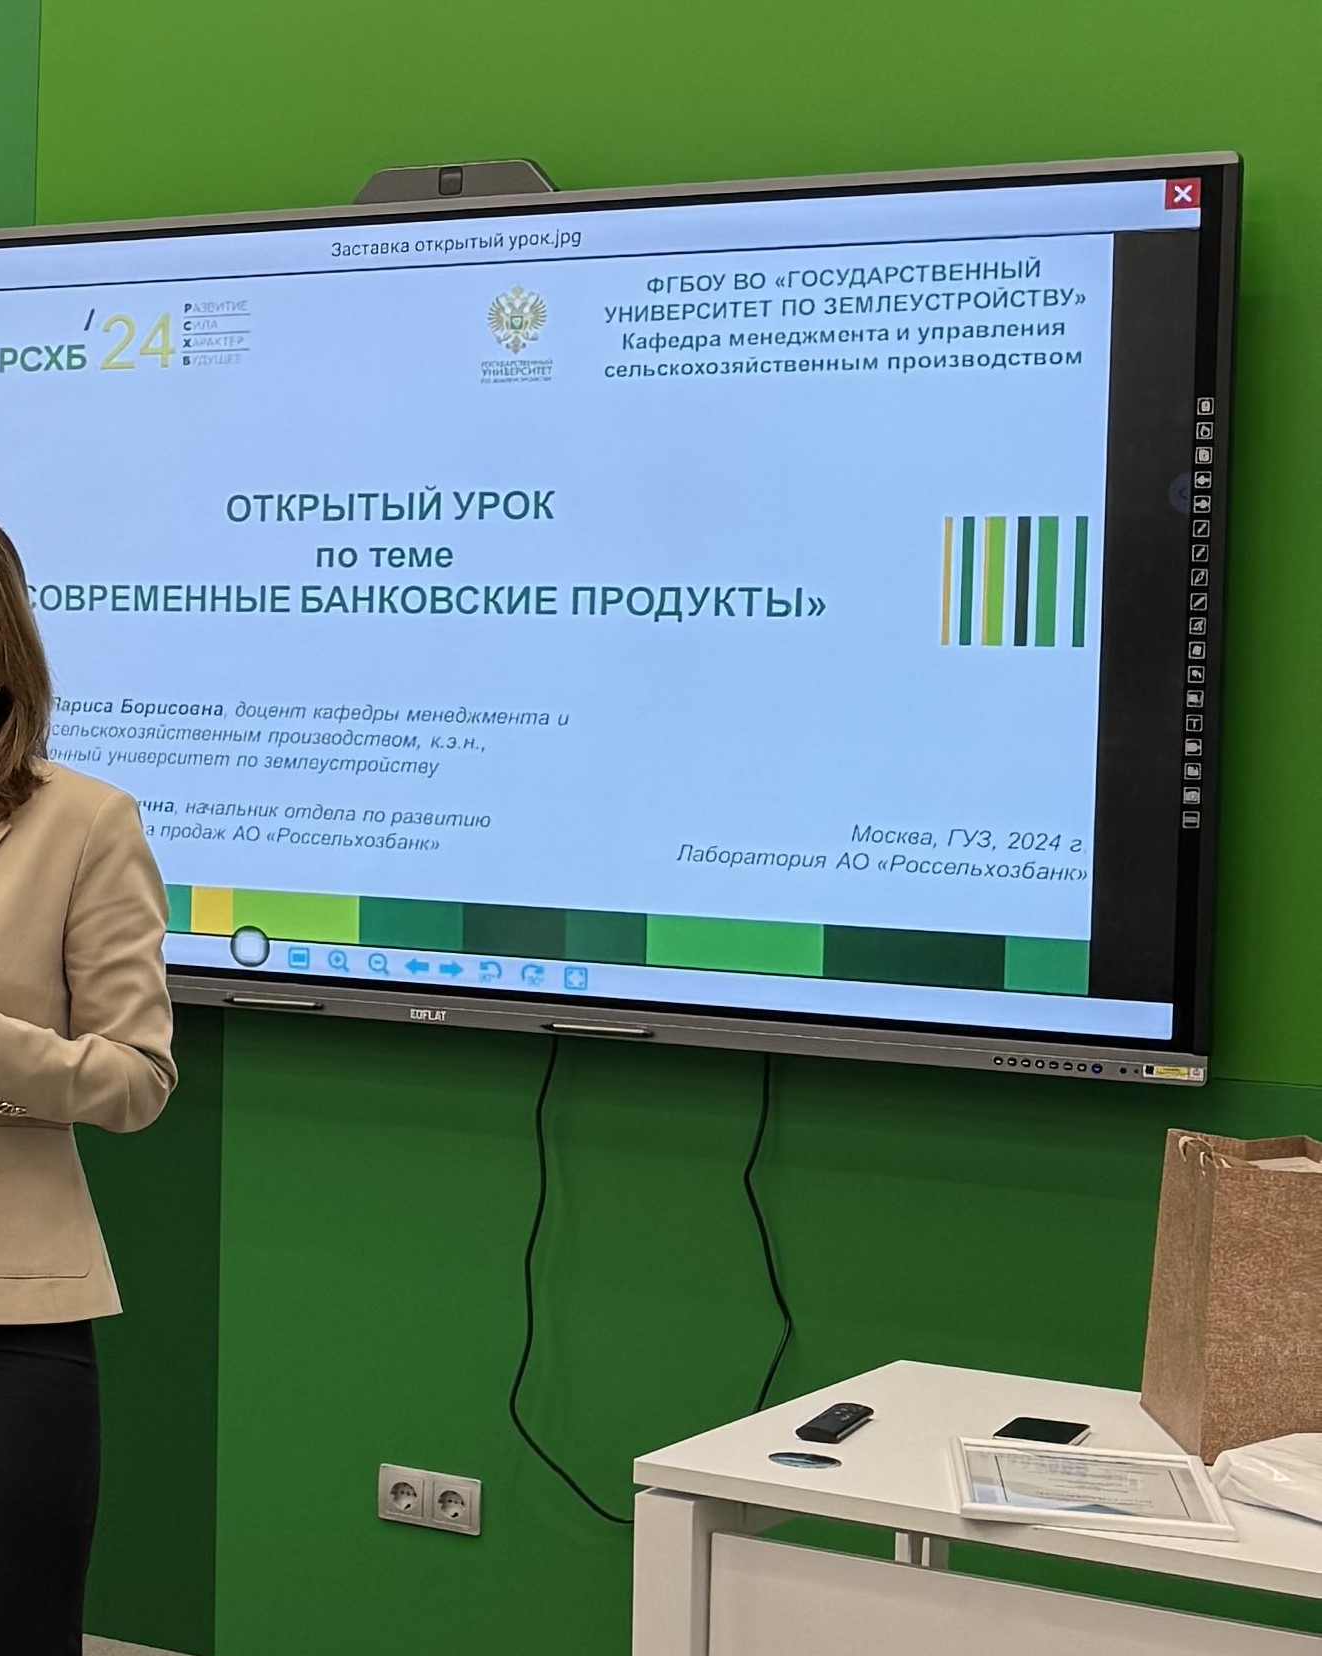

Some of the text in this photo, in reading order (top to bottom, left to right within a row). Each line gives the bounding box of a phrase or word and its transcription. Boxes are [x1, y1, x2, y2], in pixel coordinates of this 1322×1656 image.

[331, 228, 582, 258] Заставка открытый урок.jpg
[646, 255, 1041, 295] ФГБОУ ВО «ГОСУДАРСТВЕННЫЙ
[604, 286, 1086, 324] УНИВЕРСИТЕТ ПО ЗЕМЛЕУСТРОЙСТВУ»
[622, 321, 1065, 354] Кафедра менеджмента и управления
[604, 350, 1082, 378] сельскохозяйственным производством
[226, 484, 556, 523] ОТКРЫТЫЙ УРОК
[316, 546, 454, 569] по теме
[301, 584, 558, 616] БАНКОВСКИЕ
[571, 586, 827, 623] ПРОДУКТЫ»
[120, 698, 227, 719] Борисовна,
[234, 700, 307, 721] доцент
[312, 703, 400, 725] кафедры
[406, 706, 550, 726] менеджмента
[557, 713, 570, 727] и
[267, 728, 421, 751] производством,
[106, 750, 231, 768] университет
[235, 754, 259, 768] по
[263, 755, 441, 779] землеустройству
[185, 801, 279, 818] начальник
[284, 803, 356, 822] отдела
[362, 809, 386, 823] по
[389, 811, 491, 828] развитию
[160, 822, 227, 841] продаж
[232, 824, 261, 842] АО
[266, 827, 440, 851] «Россельхозбанк»
[851, 823, 937, 849] Москва,
[947, 828, 997, 852] ГУЗ,
[1007, 831, 1062, 852] 2024
[676, 843, 1088, 881] Лаборатория АО «Россельхозбанк»
